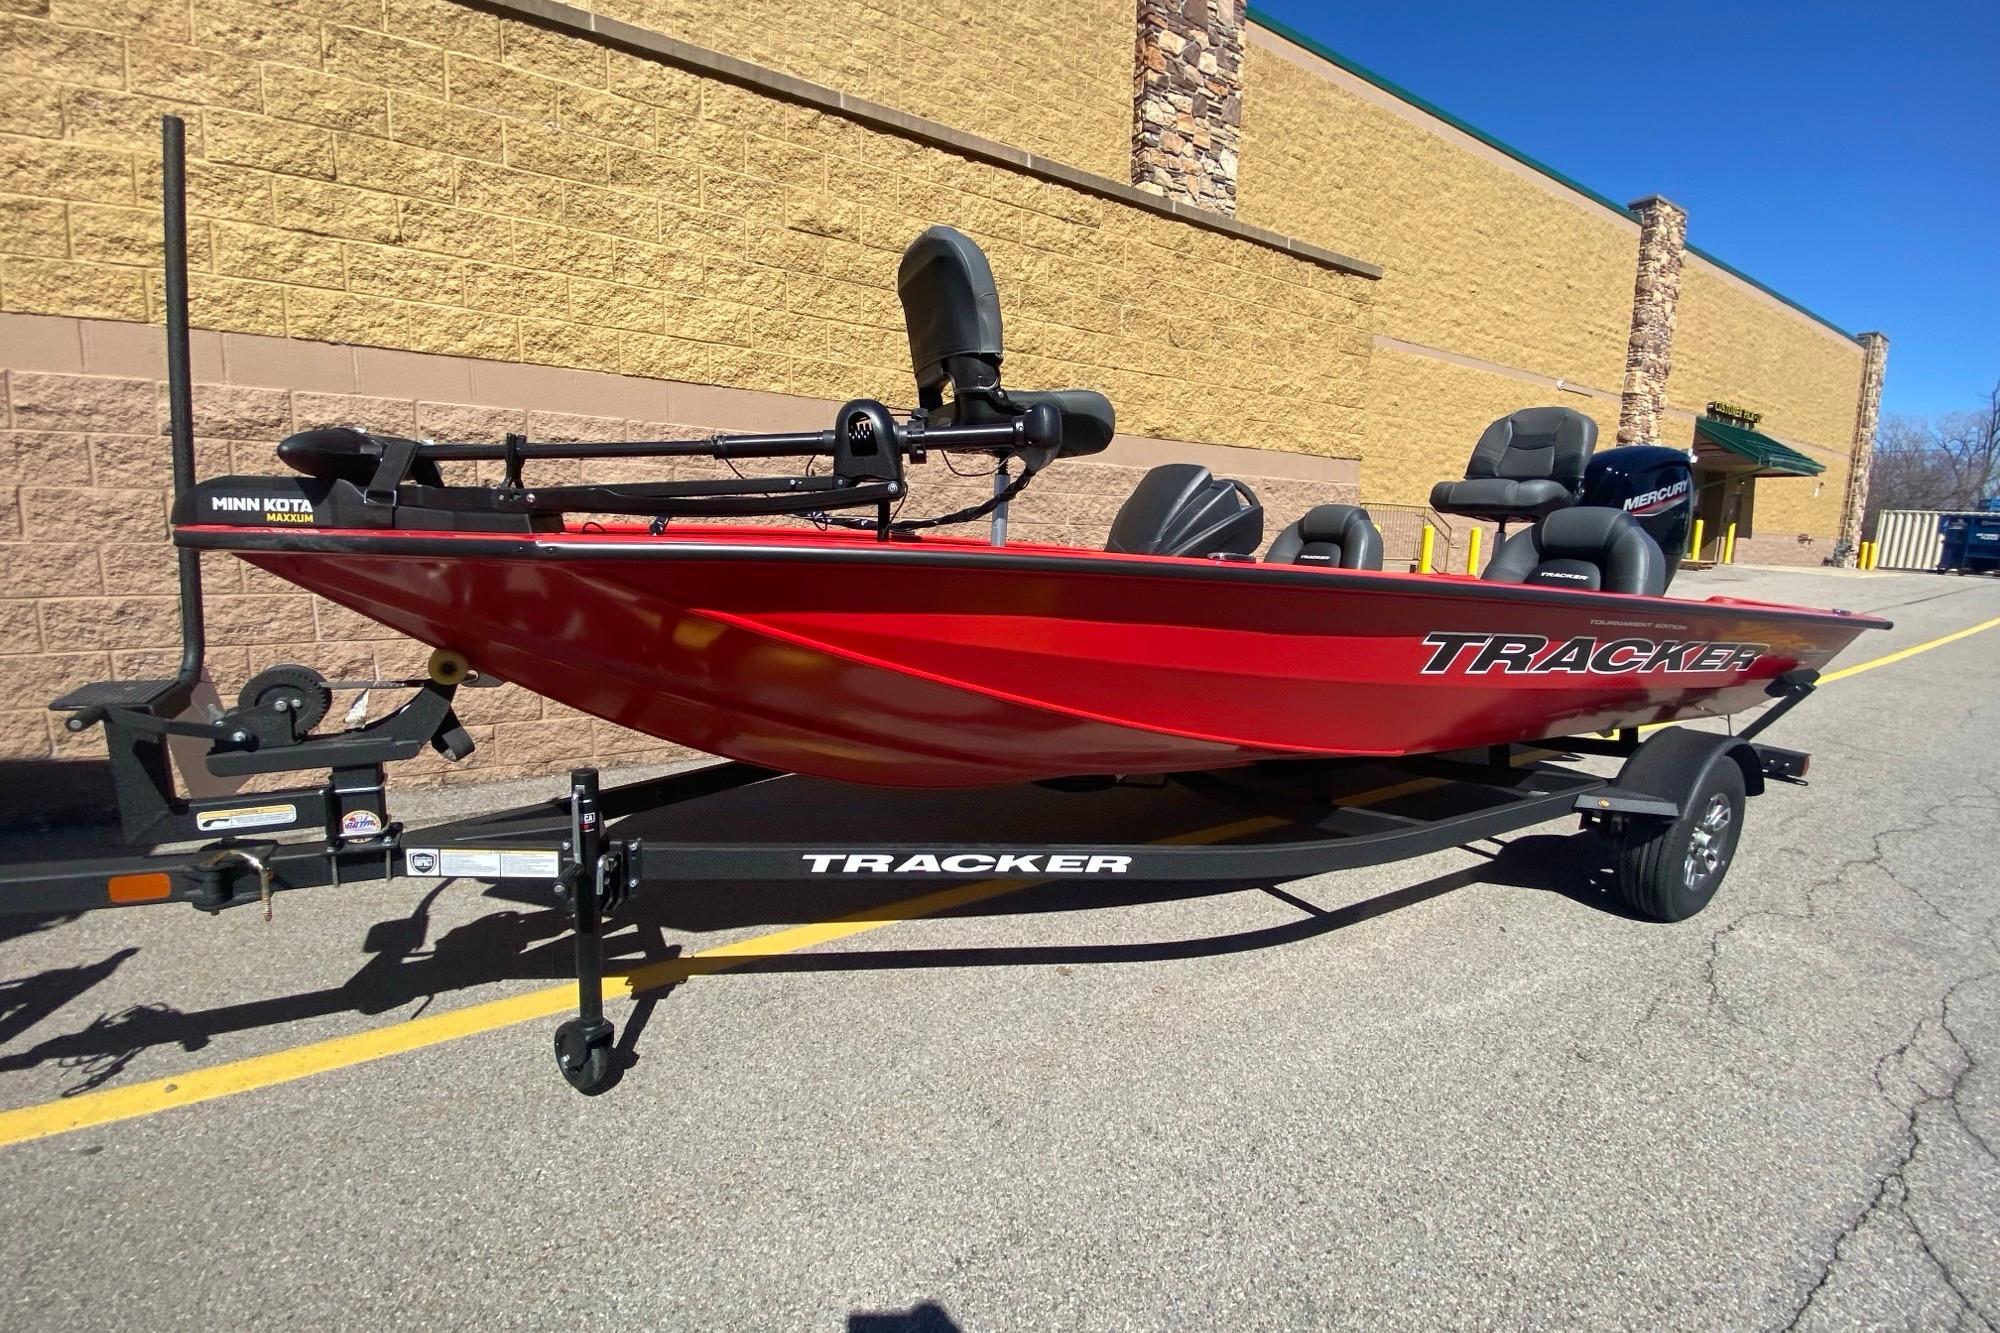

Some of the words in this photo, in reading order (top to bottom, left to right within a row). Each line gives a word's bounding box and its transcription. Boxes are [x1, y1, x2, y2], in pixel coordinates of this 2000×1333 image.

[1623, 480, 1689, 511] MERCURY
[212, 497, 260, 511] MINN
[264, 498, 313, 512] KOTA
[267, 513, 314, 523] MAXXUM
[1541, 572, 1589, 581] TRACKER
[1590, 619, 1653, 628] TOURNAMENT
[1420, 631, 1770, 675] TRACKER
[802, 854, 1134, 873] TRACKER
